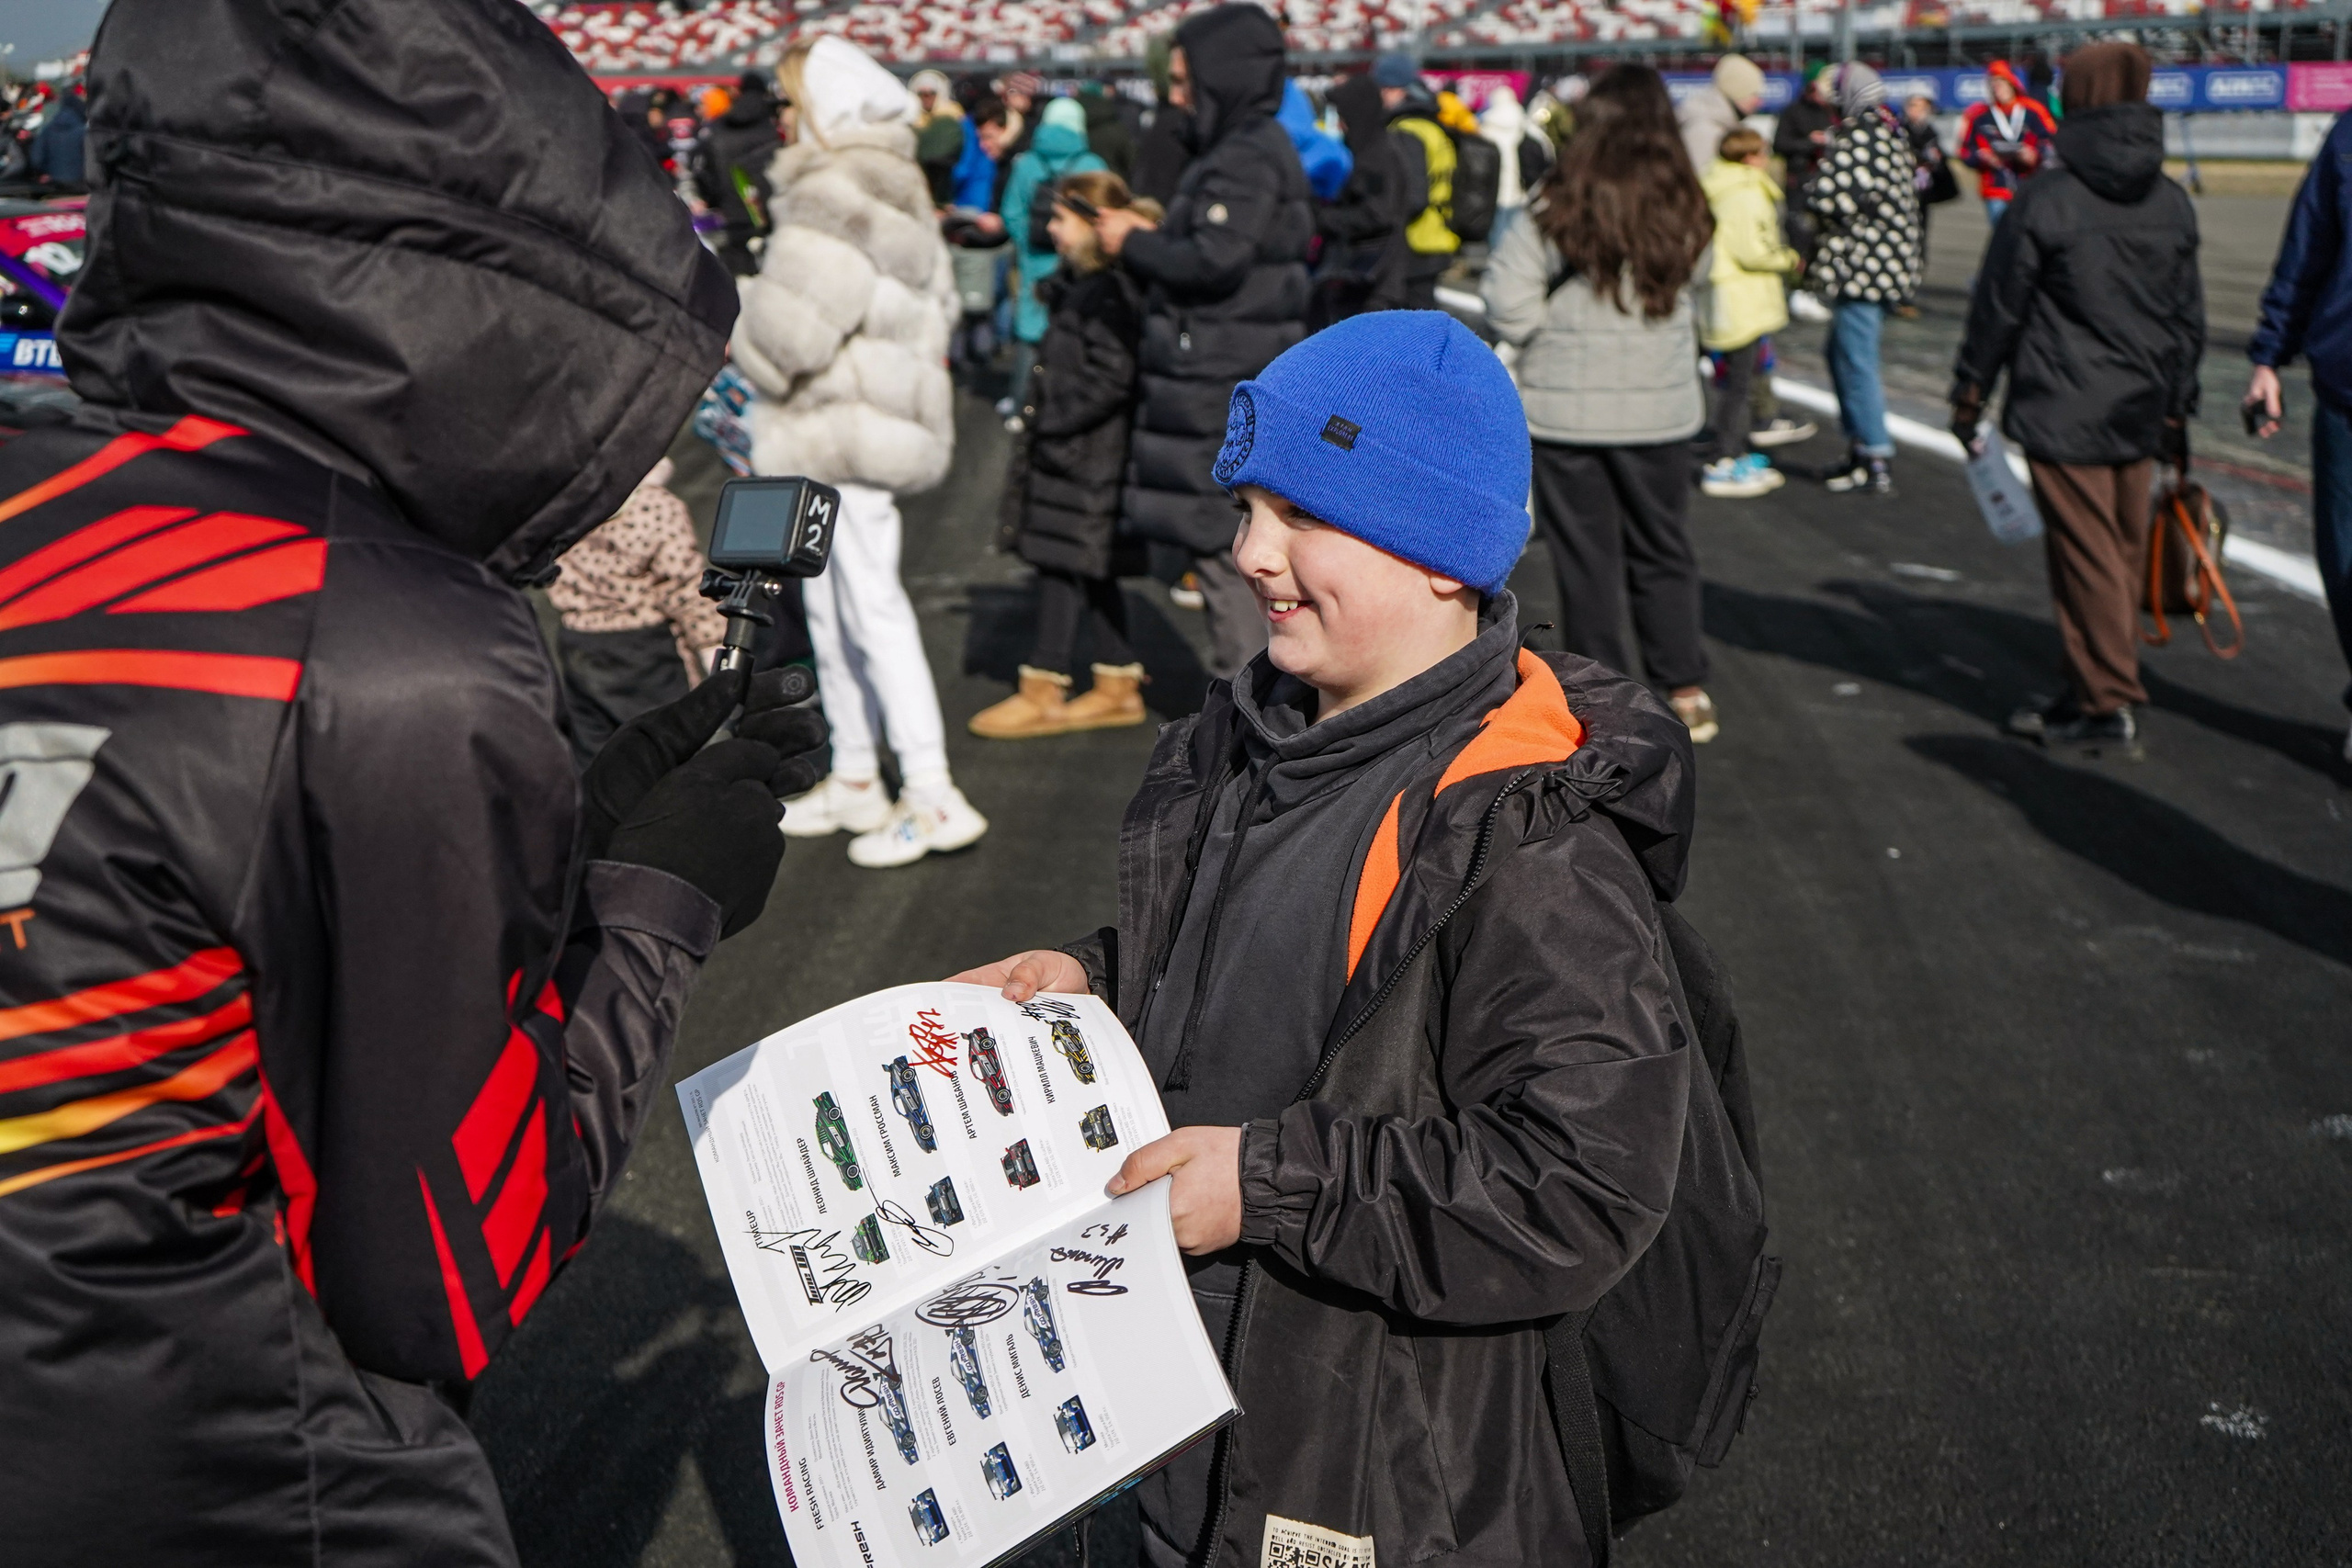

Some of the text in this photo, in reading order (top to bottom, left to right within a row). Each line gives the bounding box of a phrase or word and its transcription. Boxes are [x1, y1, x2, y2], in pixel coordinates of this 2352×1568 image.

[950, 1070, 977, 1138] АРТЕМ ШАБАНОВ
[1029, 1037, 1055, 1103] КИРИЛЛ МАЦКЕВИЧ
[704, 1125, 719, 1163] КОМАНДНЫЙ
[870, 1096, 900, 1177] МАКСИМ ГРОССМАН
[797, 1138, 827, 1213] ЛЕОНИД ШНАЙДЕР
[746, 1209, 763, 1247] TIMEUP
[1007, 1335, 1030, 1398] ДЕНИС МИГАЛЬ
[933, 1377, 956, 1446] ЕВГЕНИЙ ЛОСЕВ
[775, 1382, 798, 1512] КОМАНДНЫЙ ЗАЧЕТ RDS GP
[869, 1459, 886, 1490] ДАМИР
[799, 1458, 823, 1529] FRESH RACING
